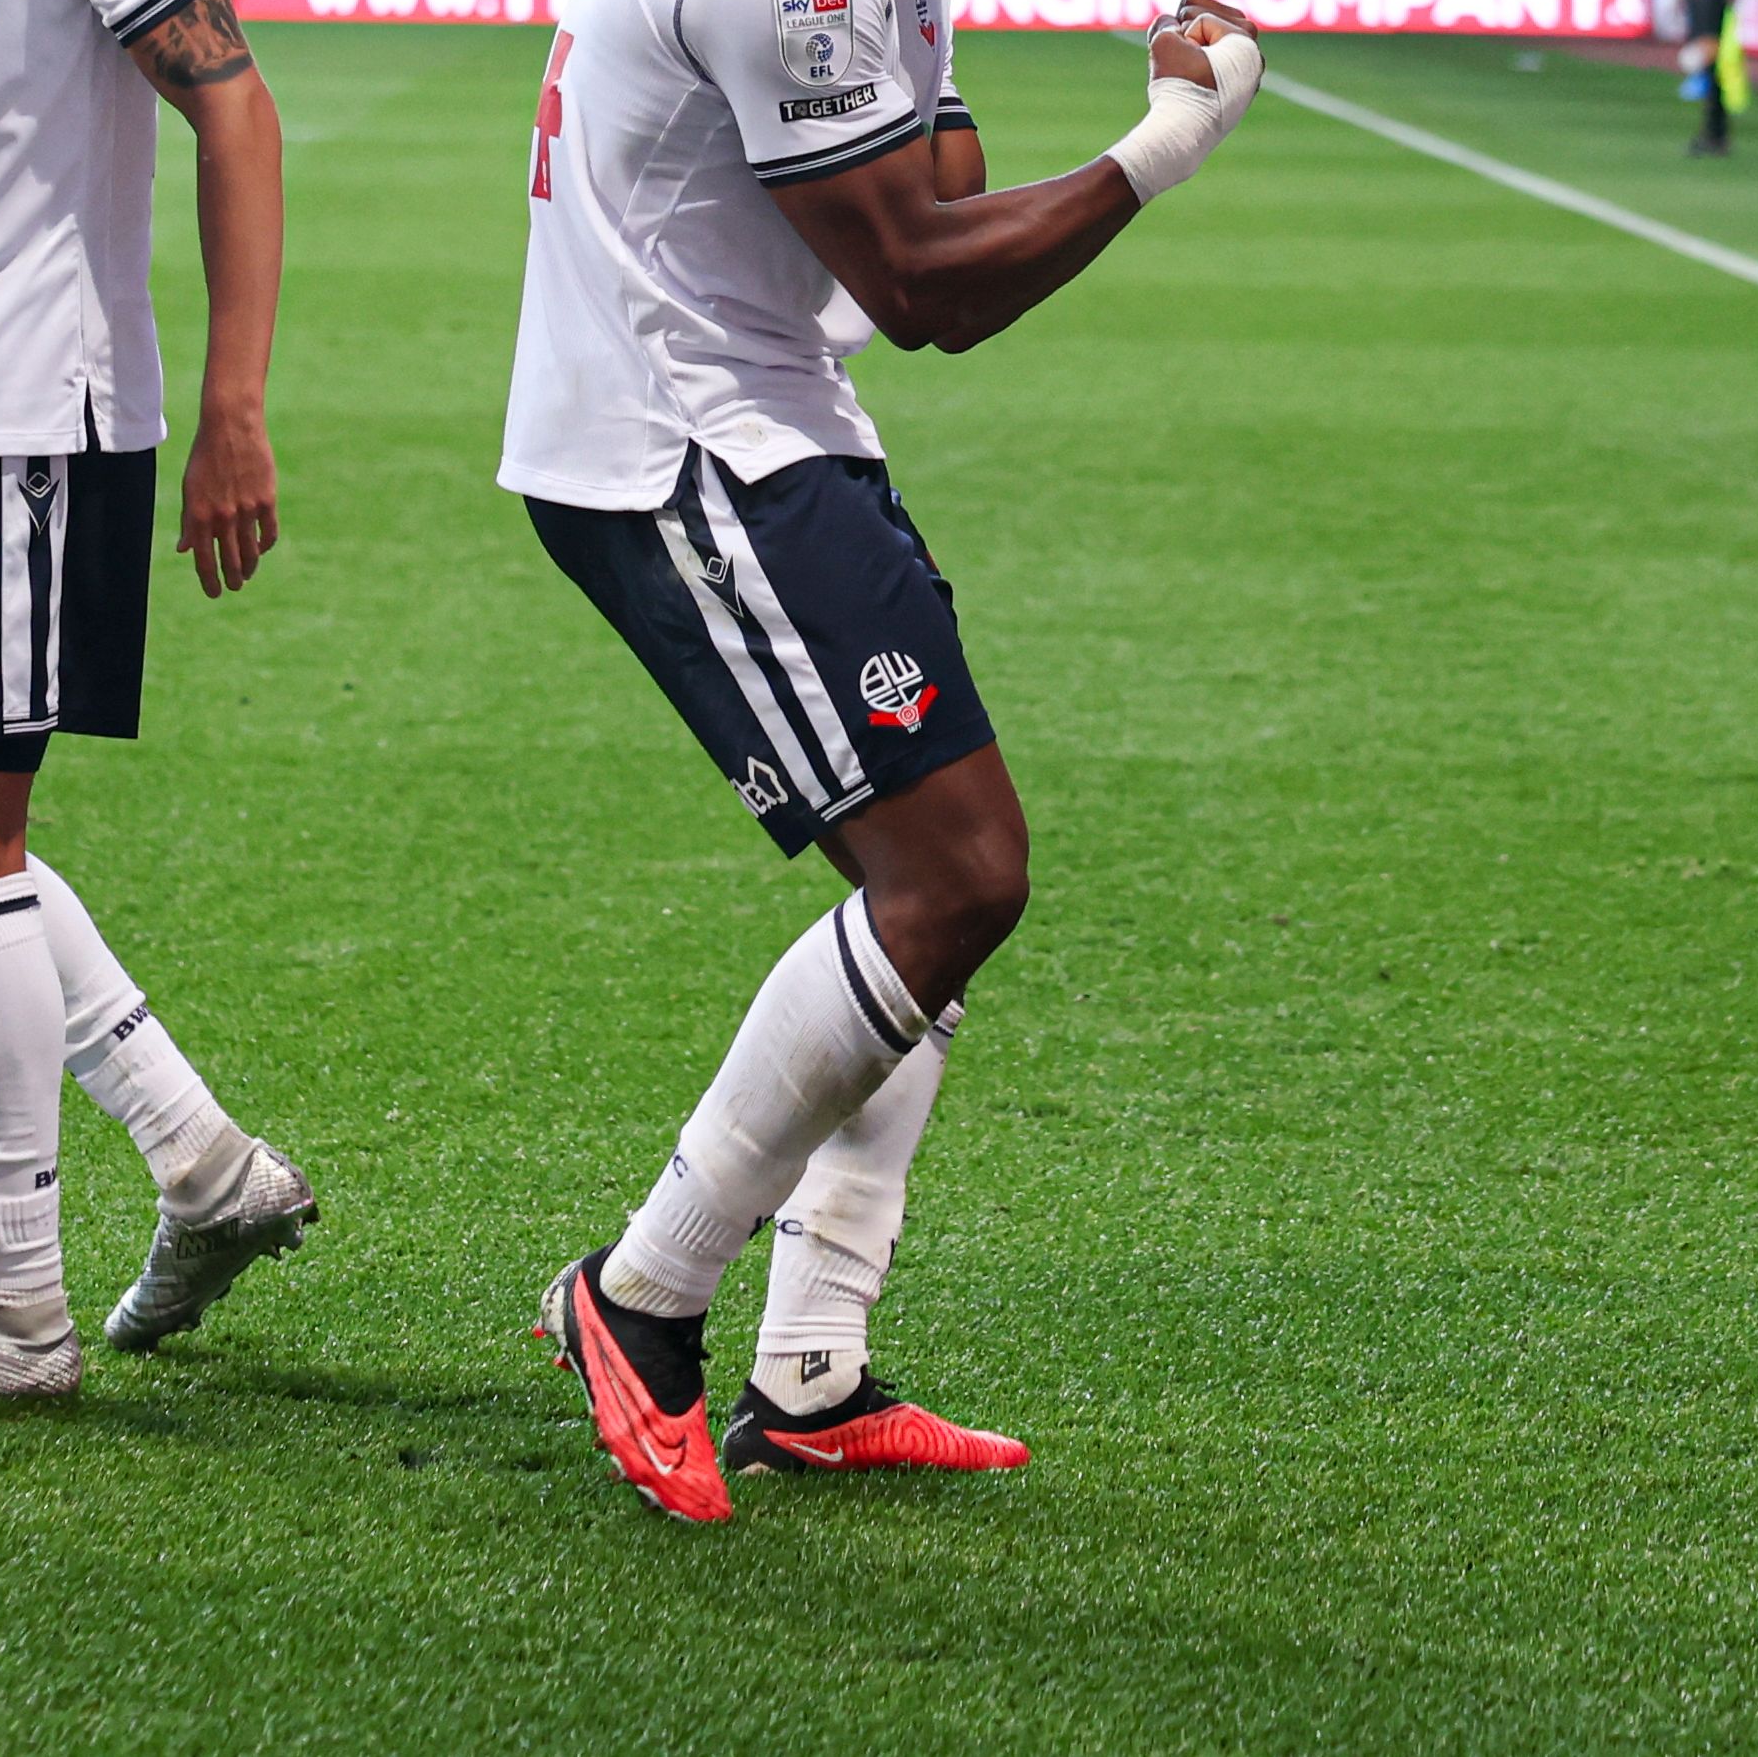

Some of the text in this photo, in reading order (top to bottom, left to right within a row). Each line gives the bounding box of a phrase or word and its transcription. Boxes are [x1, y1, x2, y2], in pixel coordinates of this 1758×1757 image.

[786, 13, 846, 29] LEAGUE ONE
[810, 64, 834, 78] EFL
